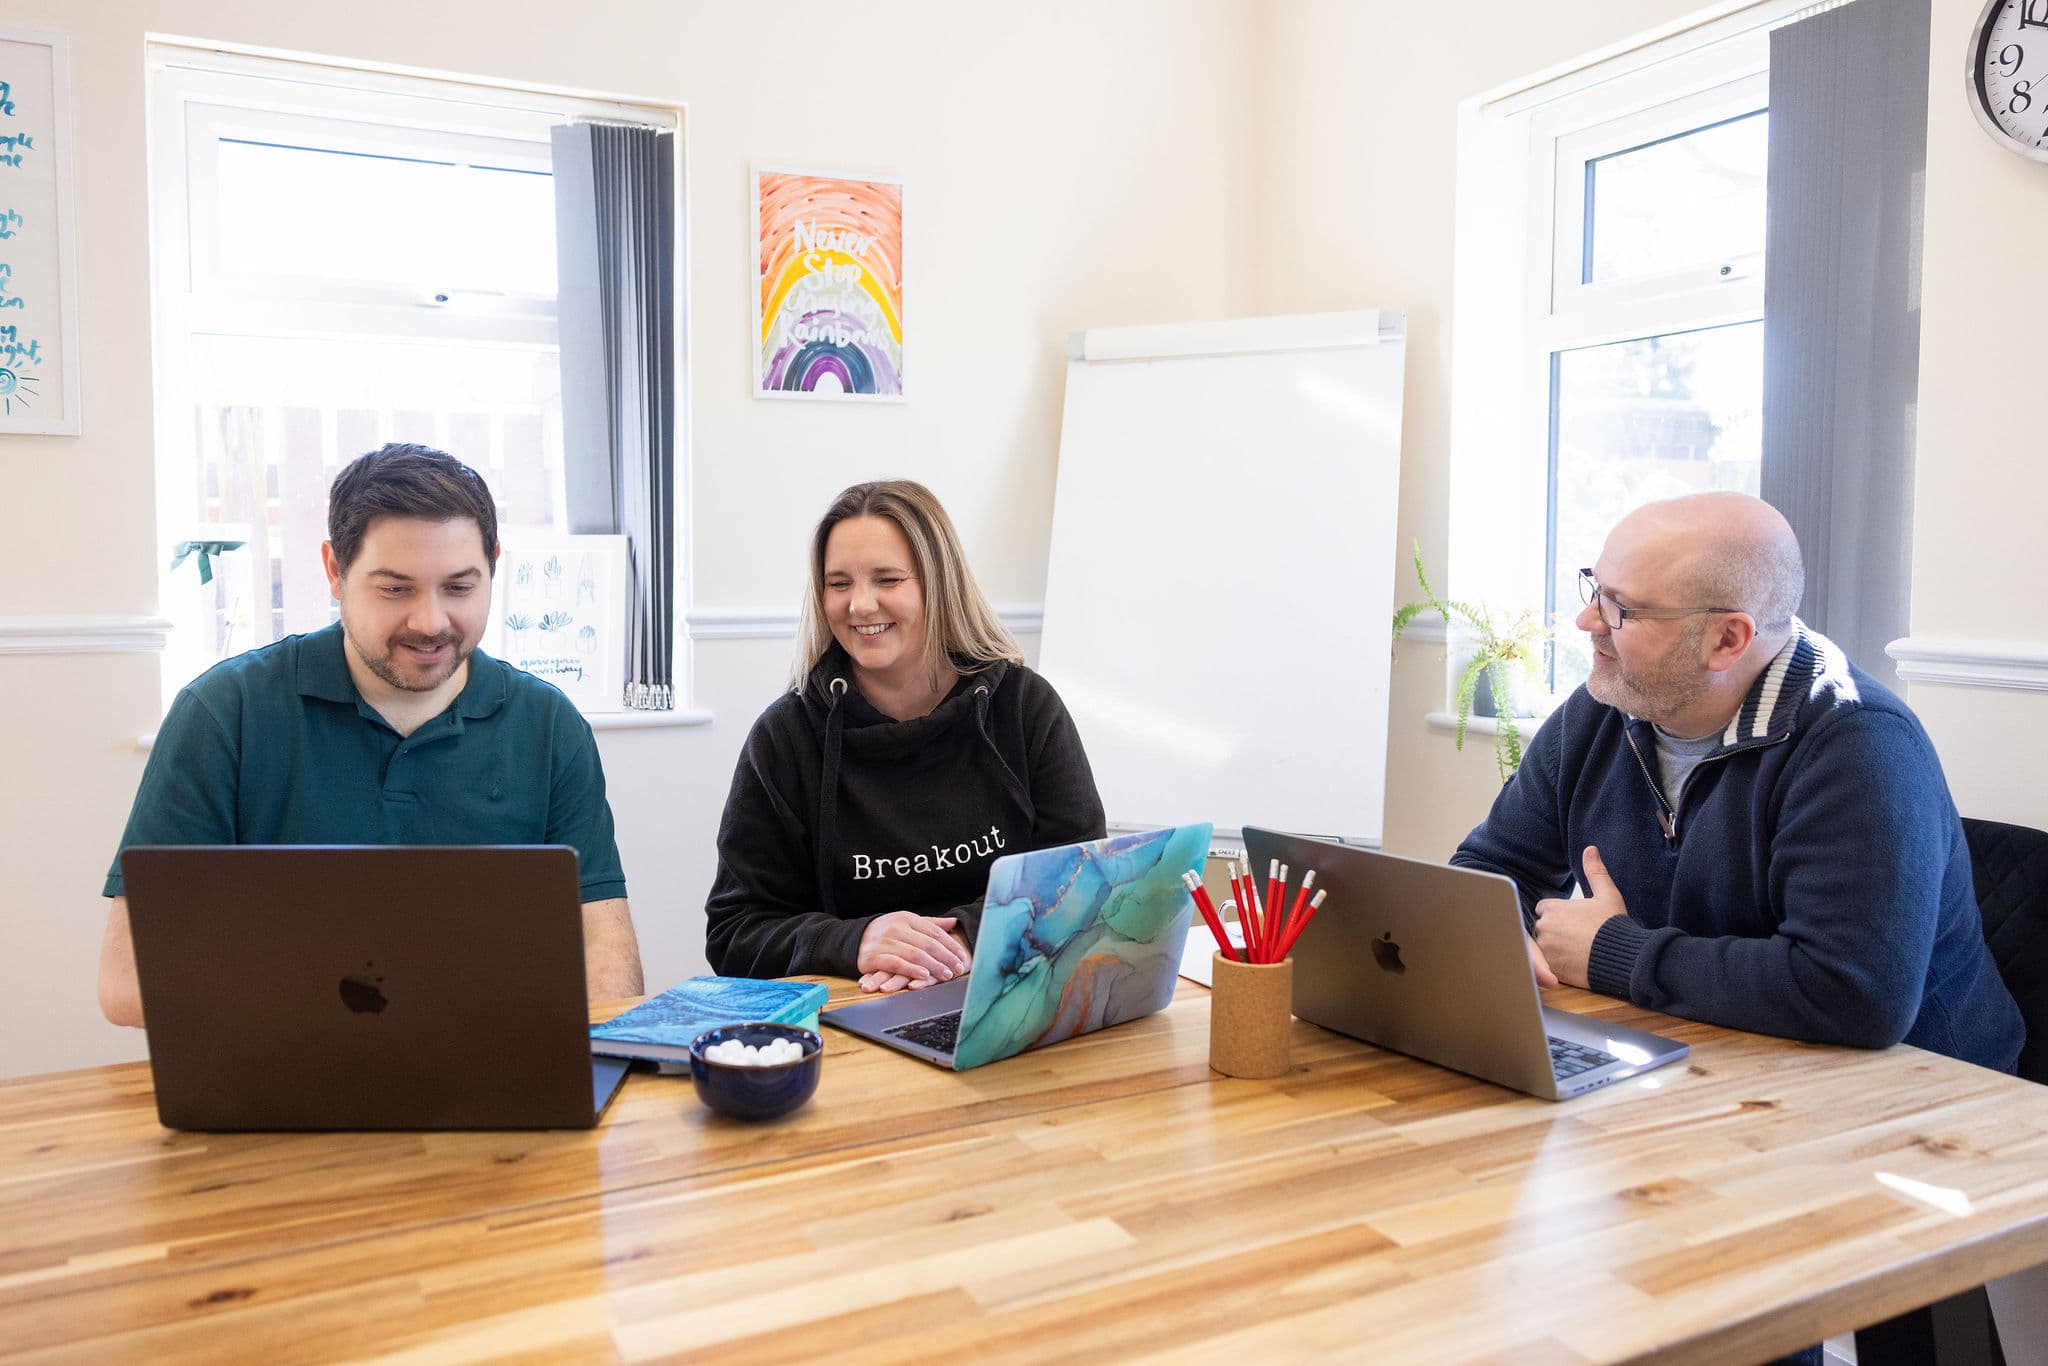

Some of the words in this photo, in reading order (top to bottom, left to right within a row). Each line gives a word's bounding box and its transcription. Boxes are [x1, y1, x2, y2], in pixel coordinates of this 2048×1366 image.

[1999, 43, 2024, 78] 9
[2008, 79, 2032, 114] 8
[793, 217, 877, 257] Never
[803, 253, 862, 292] Stop
[852, 825, 1006, 880] Breakout
